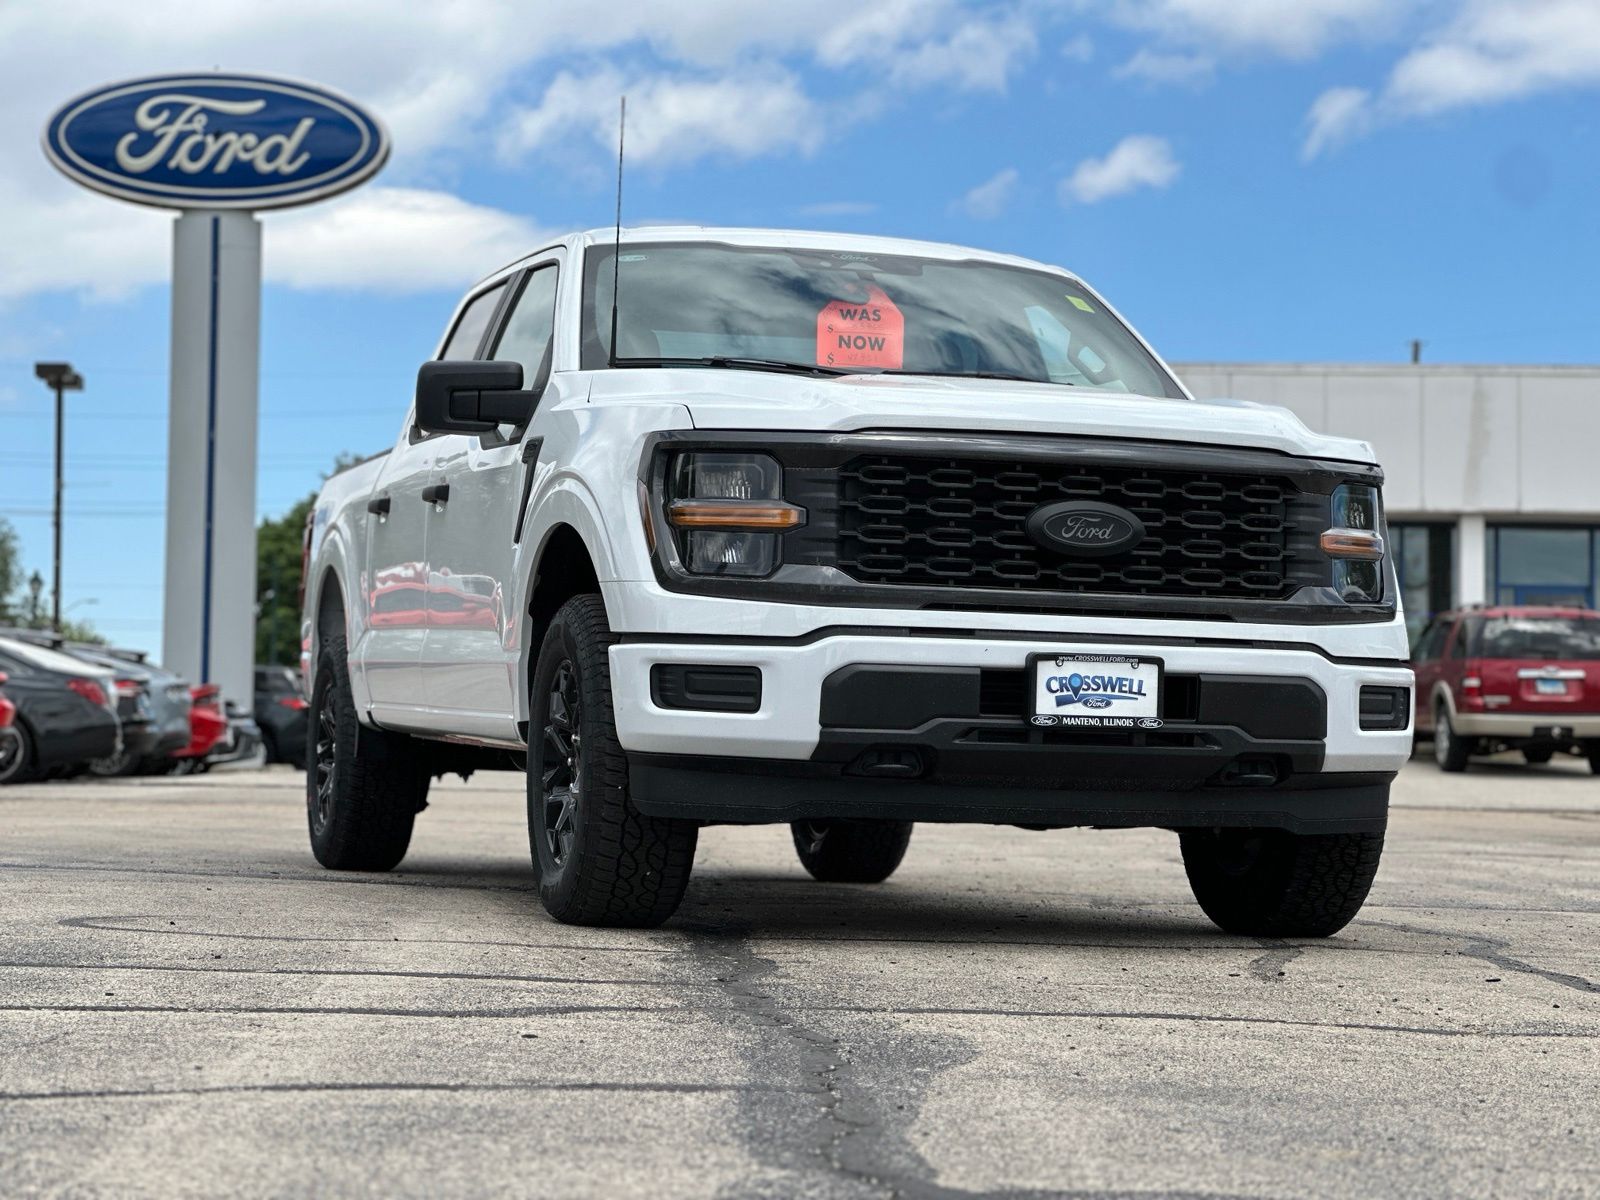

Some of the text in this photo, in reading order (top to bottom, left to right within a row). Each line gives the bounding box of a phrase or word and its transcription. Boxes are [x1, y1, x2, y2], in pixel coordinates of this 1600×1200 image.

[116, 94, 316, 175] Ford
[839, 308, 882, 322] WAS
[838, 335, 886, 351] NOW
[1061, 515, 1115, 539] Ford
[1045, 673, 1147, 697] CROSSWELL
[1087, 698, 1107, 707] Ford
[1036, 716, 1053, 725] Ford
[1062, 717, 1134, 727] MANTENO, ILLINOIS
[1142, 718, 1159, 727] Ford
